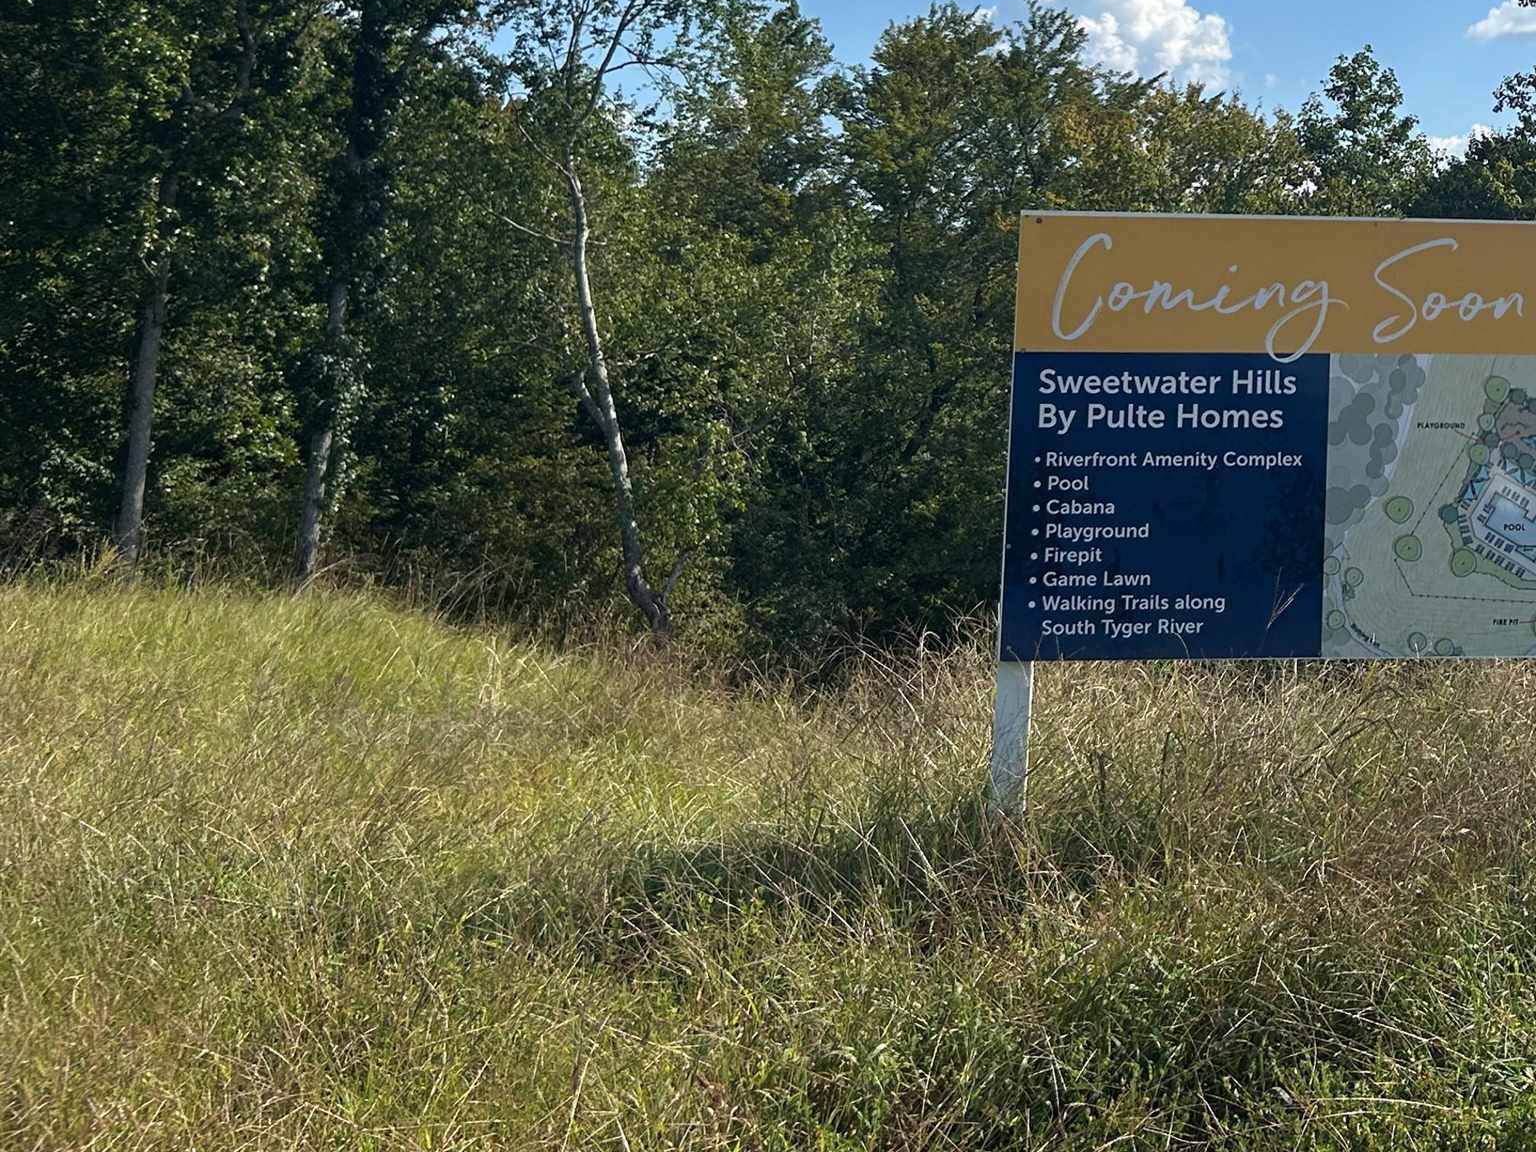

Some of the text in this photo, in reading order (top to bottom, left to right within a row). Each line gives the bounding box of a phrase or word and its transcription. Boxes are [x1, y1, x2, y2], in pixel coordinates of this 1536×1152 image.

[1052, 233, 1524, 363] Coming Soon
[1039, 368, 1297, 394] Sweetwater Hills
[1038, 403, 1283, 435] By Pulte Homes
[1046, 452, 1302, 470] Riverfront Amenity Complex
[1048, 476, 1089, 490] Pool
[1046, 500, 1115, 514] Cabana
[1045, 524, 1149, 542] Playground
[1503, 523, 1525, 531] POOL
[1044, 548, 1102, 565] Firepit
[1043, 571, 1151, 586] Game Lawn
[1042, 594, 1226, 614] Walking Trails along
[1041, 619, 1203, 637] South Tyger River
